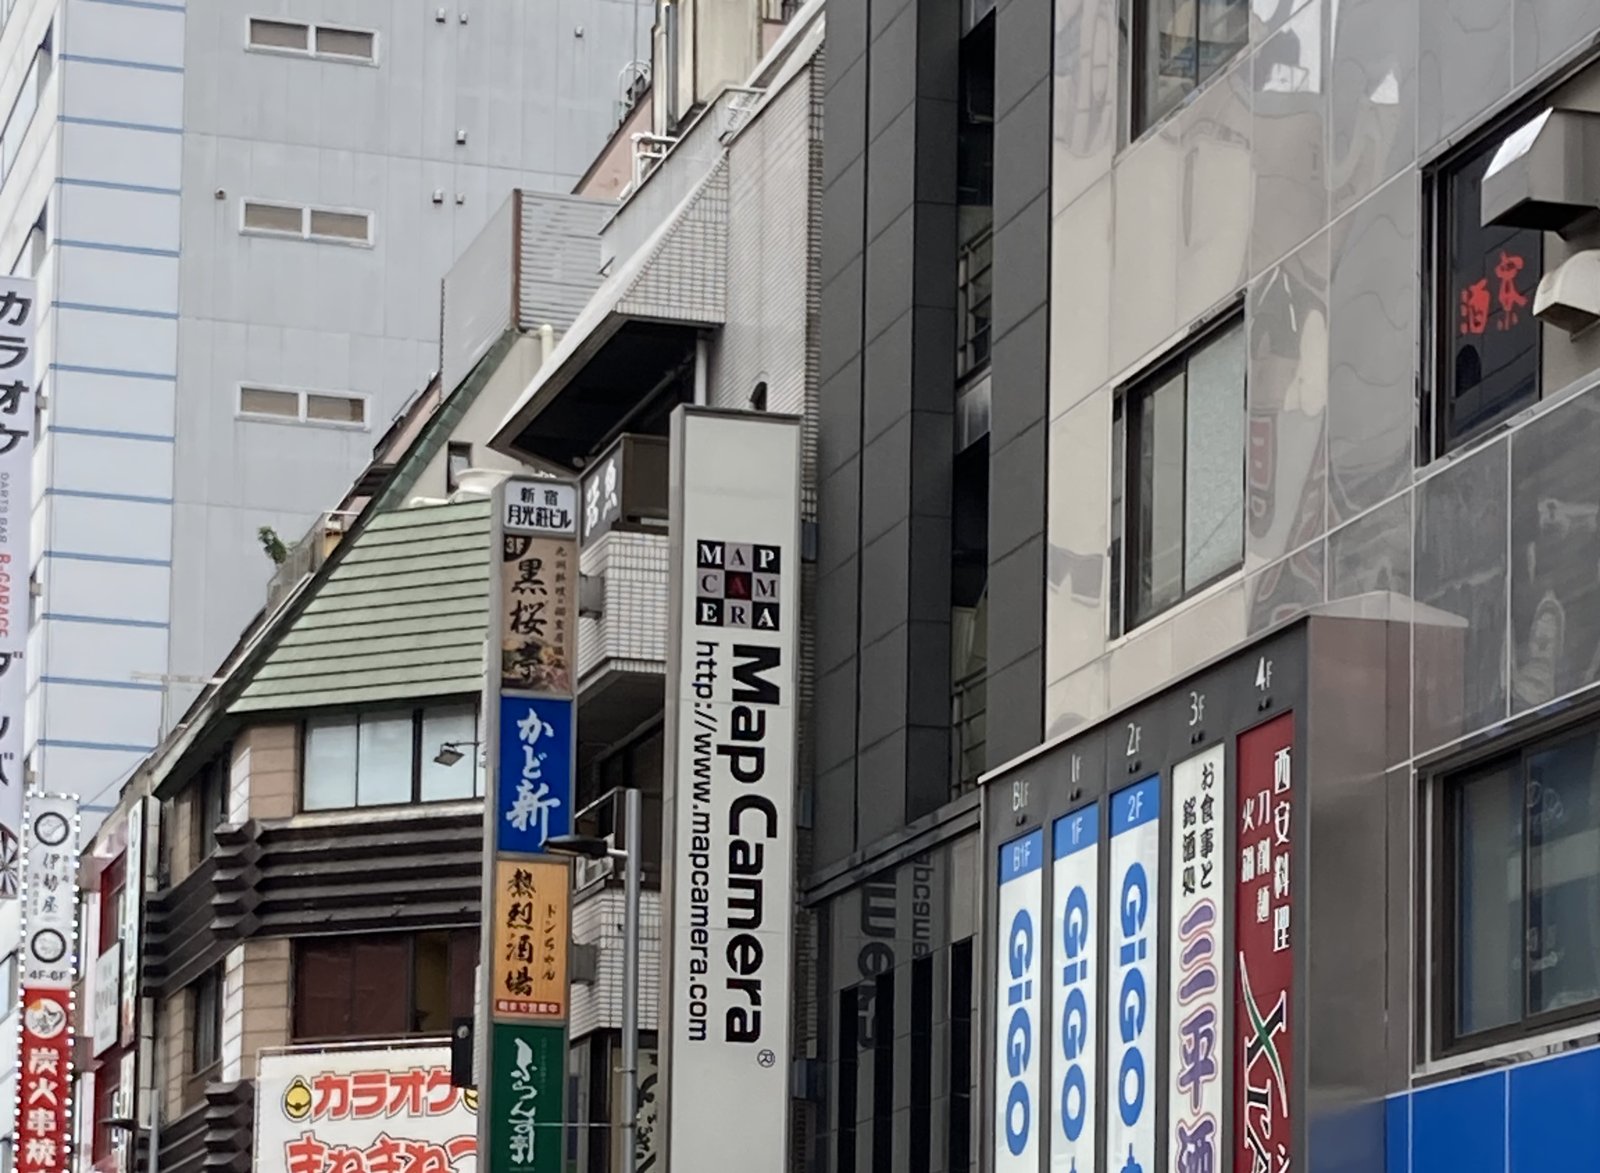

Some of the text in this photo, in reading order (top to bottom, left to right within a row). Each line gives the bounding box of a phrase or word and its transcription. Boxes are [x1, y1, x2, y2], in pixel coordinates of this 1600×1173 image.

[0, 291, 32, 456] カラオケ
[521, 487, 559, 506] 新宿
[506, 537, 525, 555] 3F
[700, 543, 775, 569] MAP
[701, 574, 777, 598] CAM
[509, 558, 548, 679] 黒桜亭
[701, 603, 775, 628] ERA
[1255, 656, 1273, 691] 4F
[1189, 691, 1205, 726] 3F
[1126, 722, 1141, 756] 2F
[505, 707, 561, 847] かど新
[1071, 754, 1082, 783] 1F
[1013, 781, 1029, 811] B1F
[1127, 790, 1144, 823] 2F
[688, 640, 719, 1042] http://www.mapcamera.com
[1071, 816, 1083, 845] 1F
[1200, 761, 1215, 889] お食事と
[1013, 840, 1031, 872] B1F
[505, 868, 537, 997] 熱烈酒場
[542, 904, 557, 981] ドンちゃん
[1118, 861, 1149, 1127] GiGO
[1061, 885, 1089, 1142] GiGO
[1005, 908, 1034, 1156] GiGO
[26, 1046, 60, 1173] 炭火串焼
[311, 1066, 461, 1123] カラオケ
